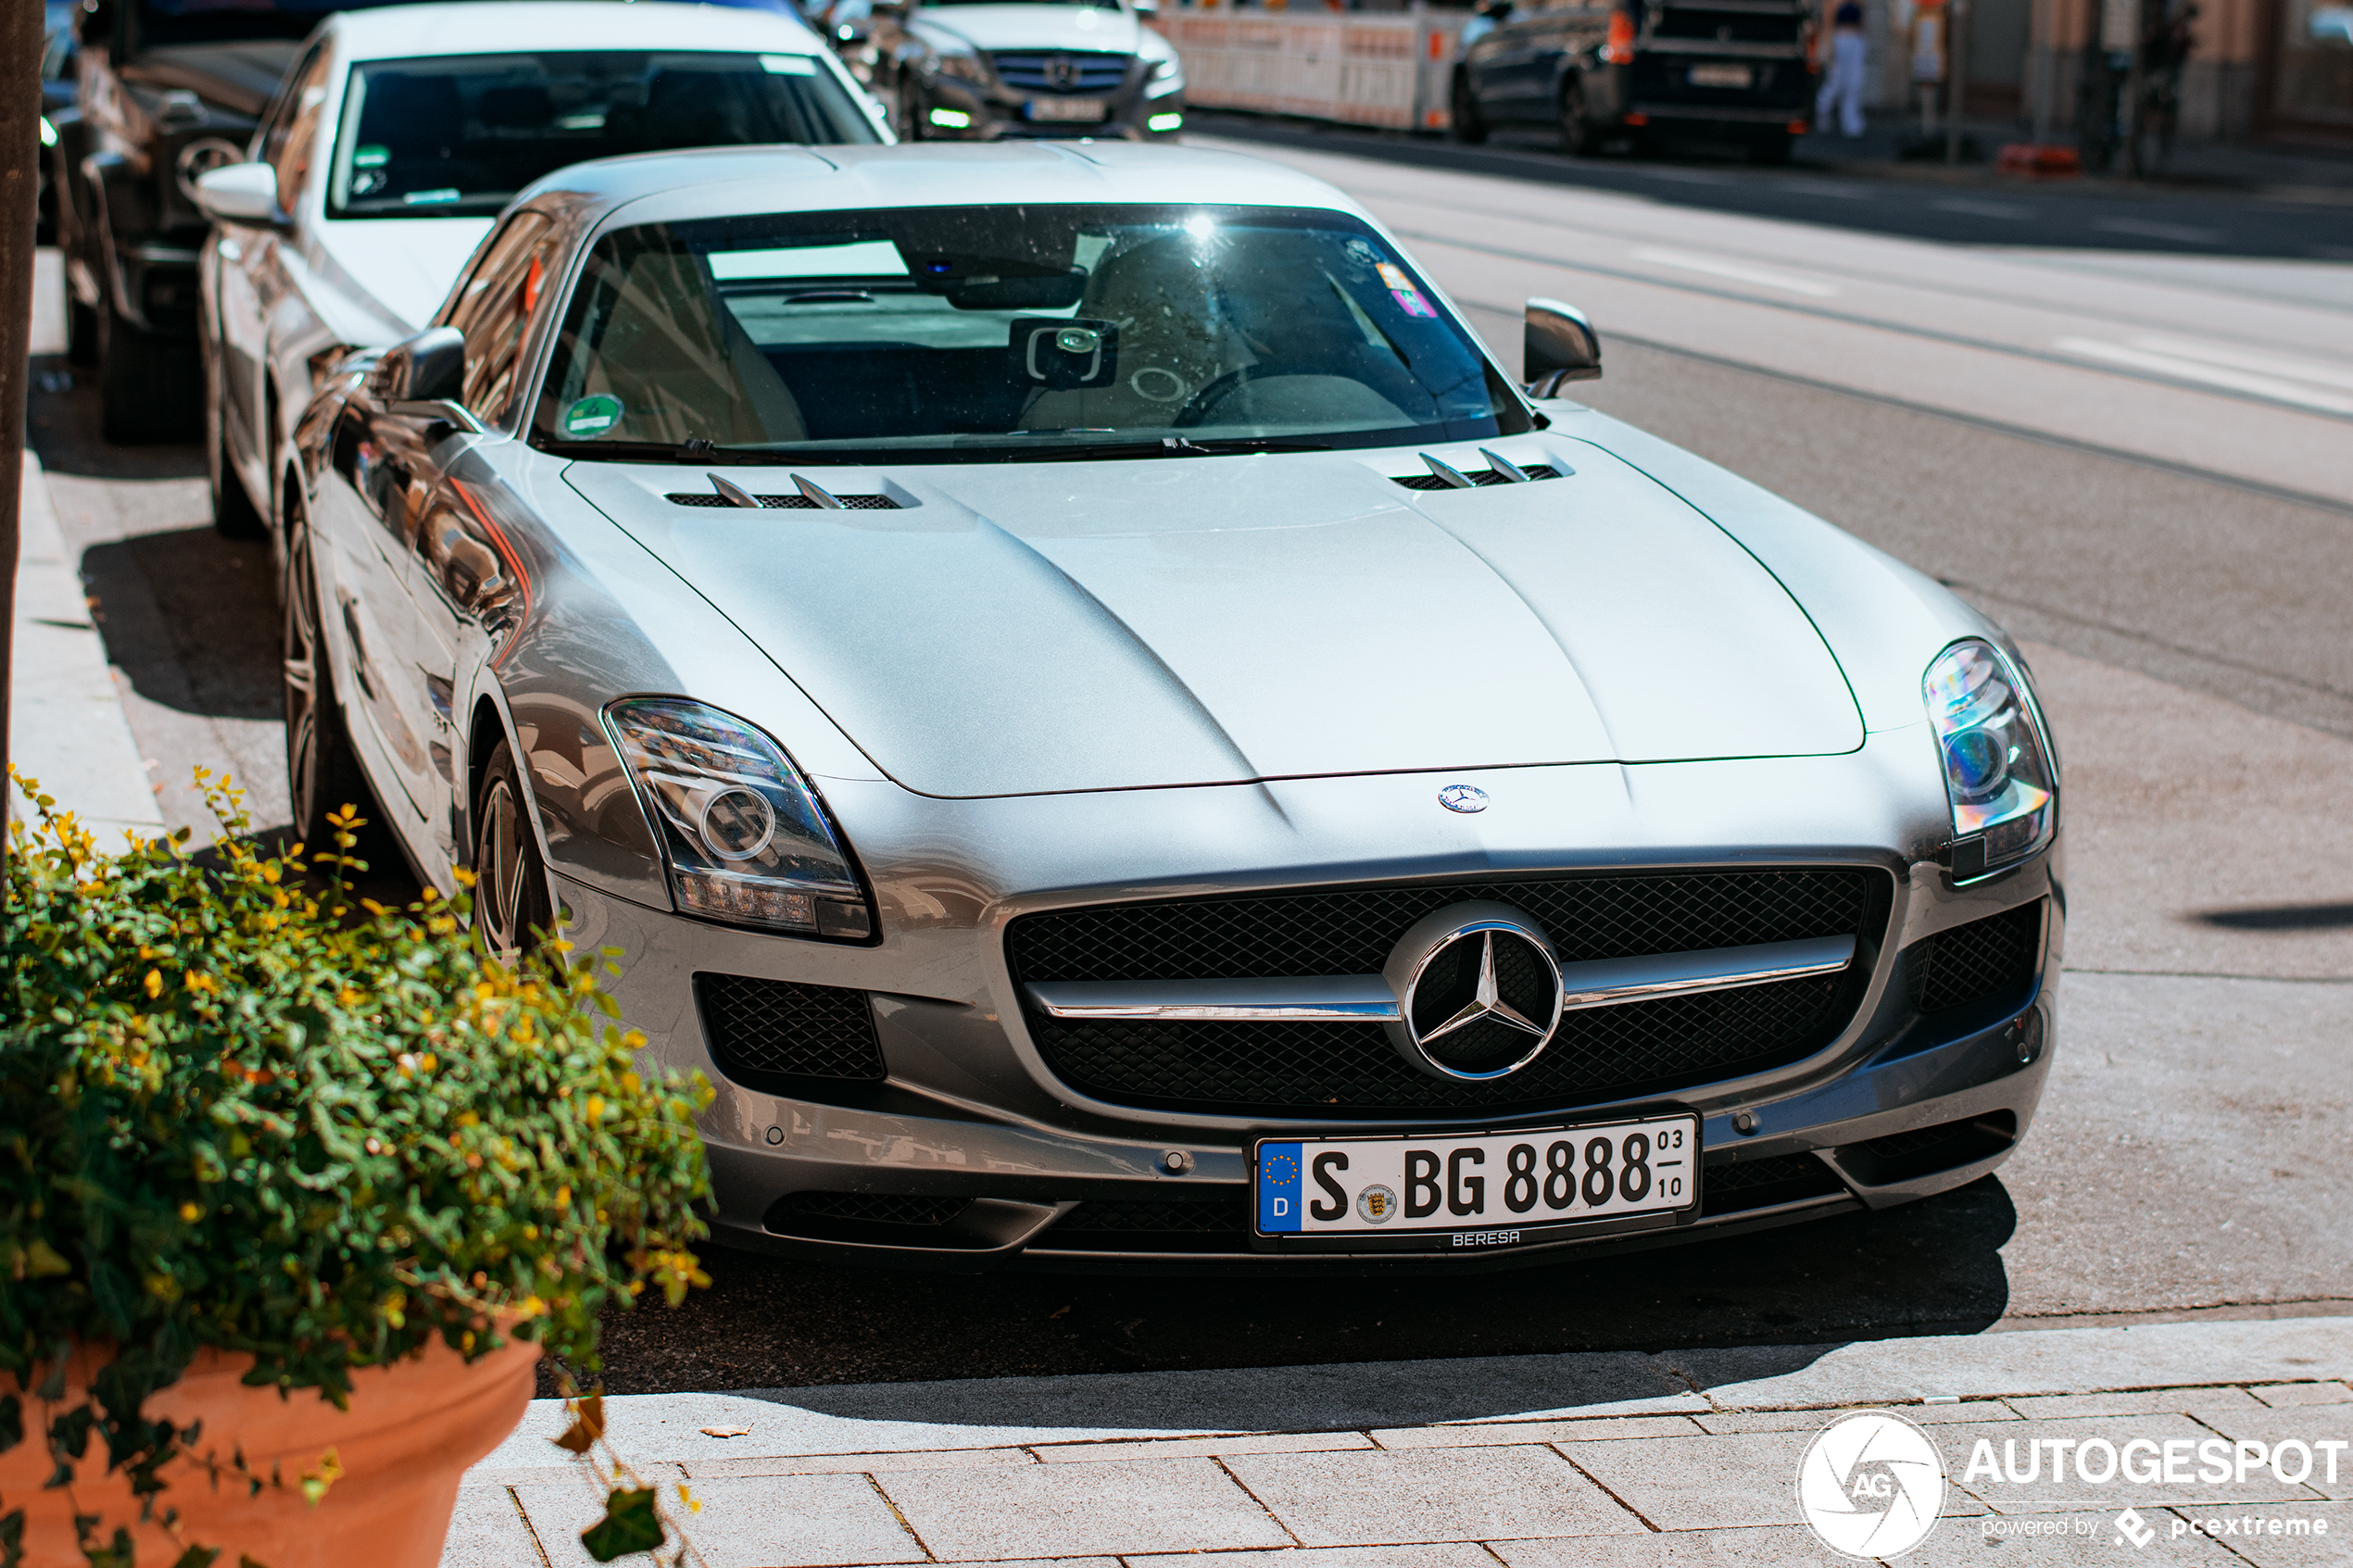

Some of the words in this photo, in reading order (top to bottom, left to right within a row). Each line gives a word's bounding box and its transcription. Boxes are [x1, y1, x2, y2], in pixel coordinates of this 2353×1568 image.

[1657, 1129, 1683, 1150] 03
[1310, 1151, 1349, 1222] S
[1404, 1148, 1485, 1218] BG
[1504, 1131, 1652, 1213] 8888
[1658, 1177, 1681, 1198] 10
[1274, 1198, 1289, 1217] D
[1453, 1231, 1520, 1247] BERESA
